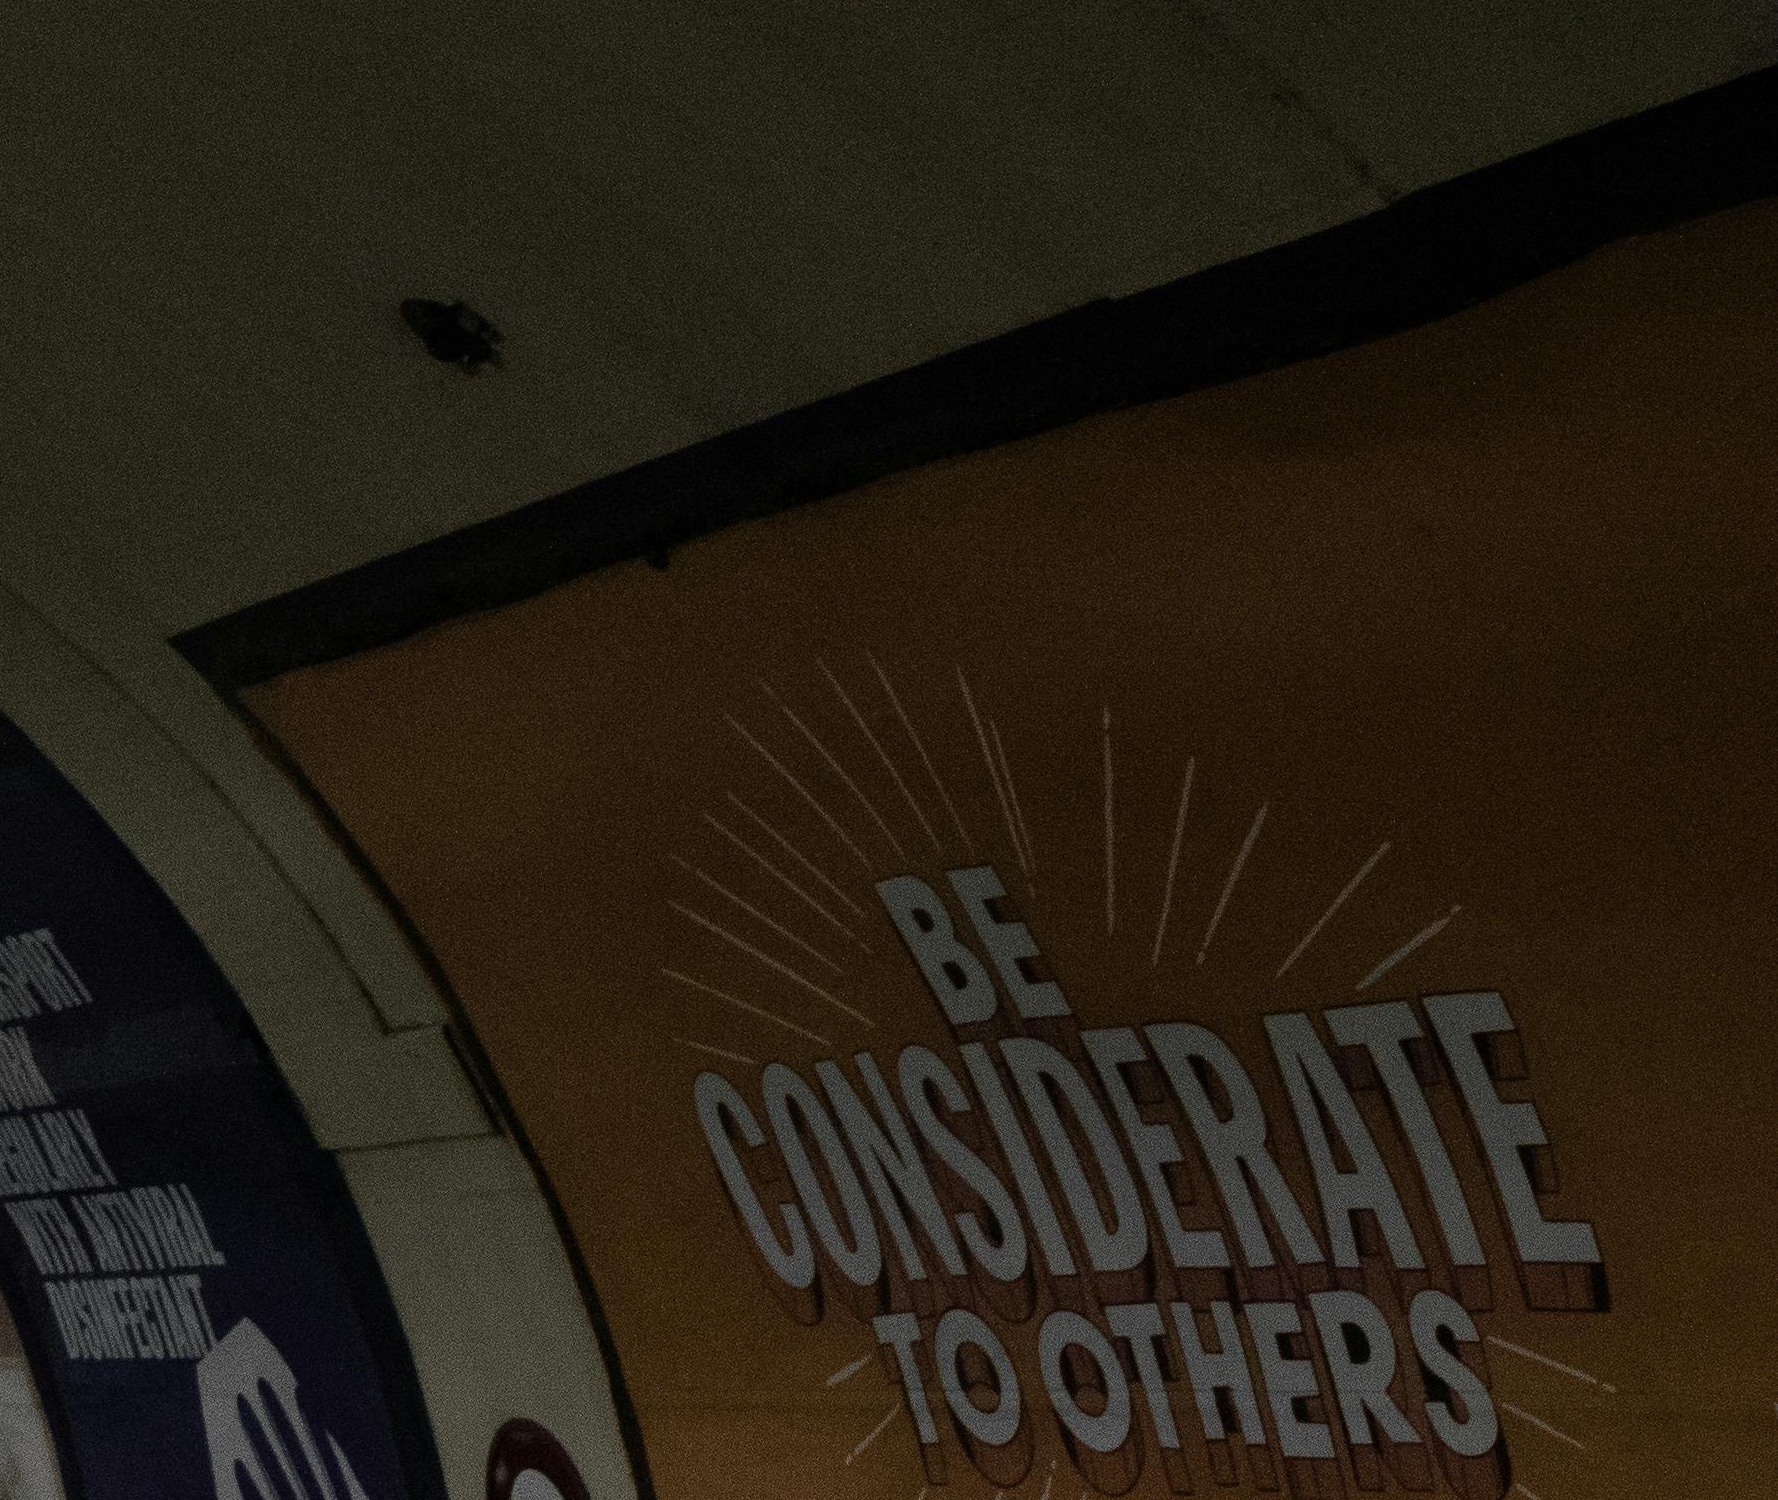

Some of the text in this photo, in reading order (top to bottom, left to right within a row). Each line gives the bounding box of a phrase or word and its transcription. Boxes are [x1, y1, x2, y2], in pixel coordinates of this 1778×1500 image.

[876, 865, 1073, 1026] BE
[693, 991, 1605, 1300] CONSIDERATE
[5, 1183, 226, 1276] WITH ANTIVIRAL
[45, 1274, 217, 1359] DISINFECTANT
[873, 1290, 1500, 1462] TO OTHERS
